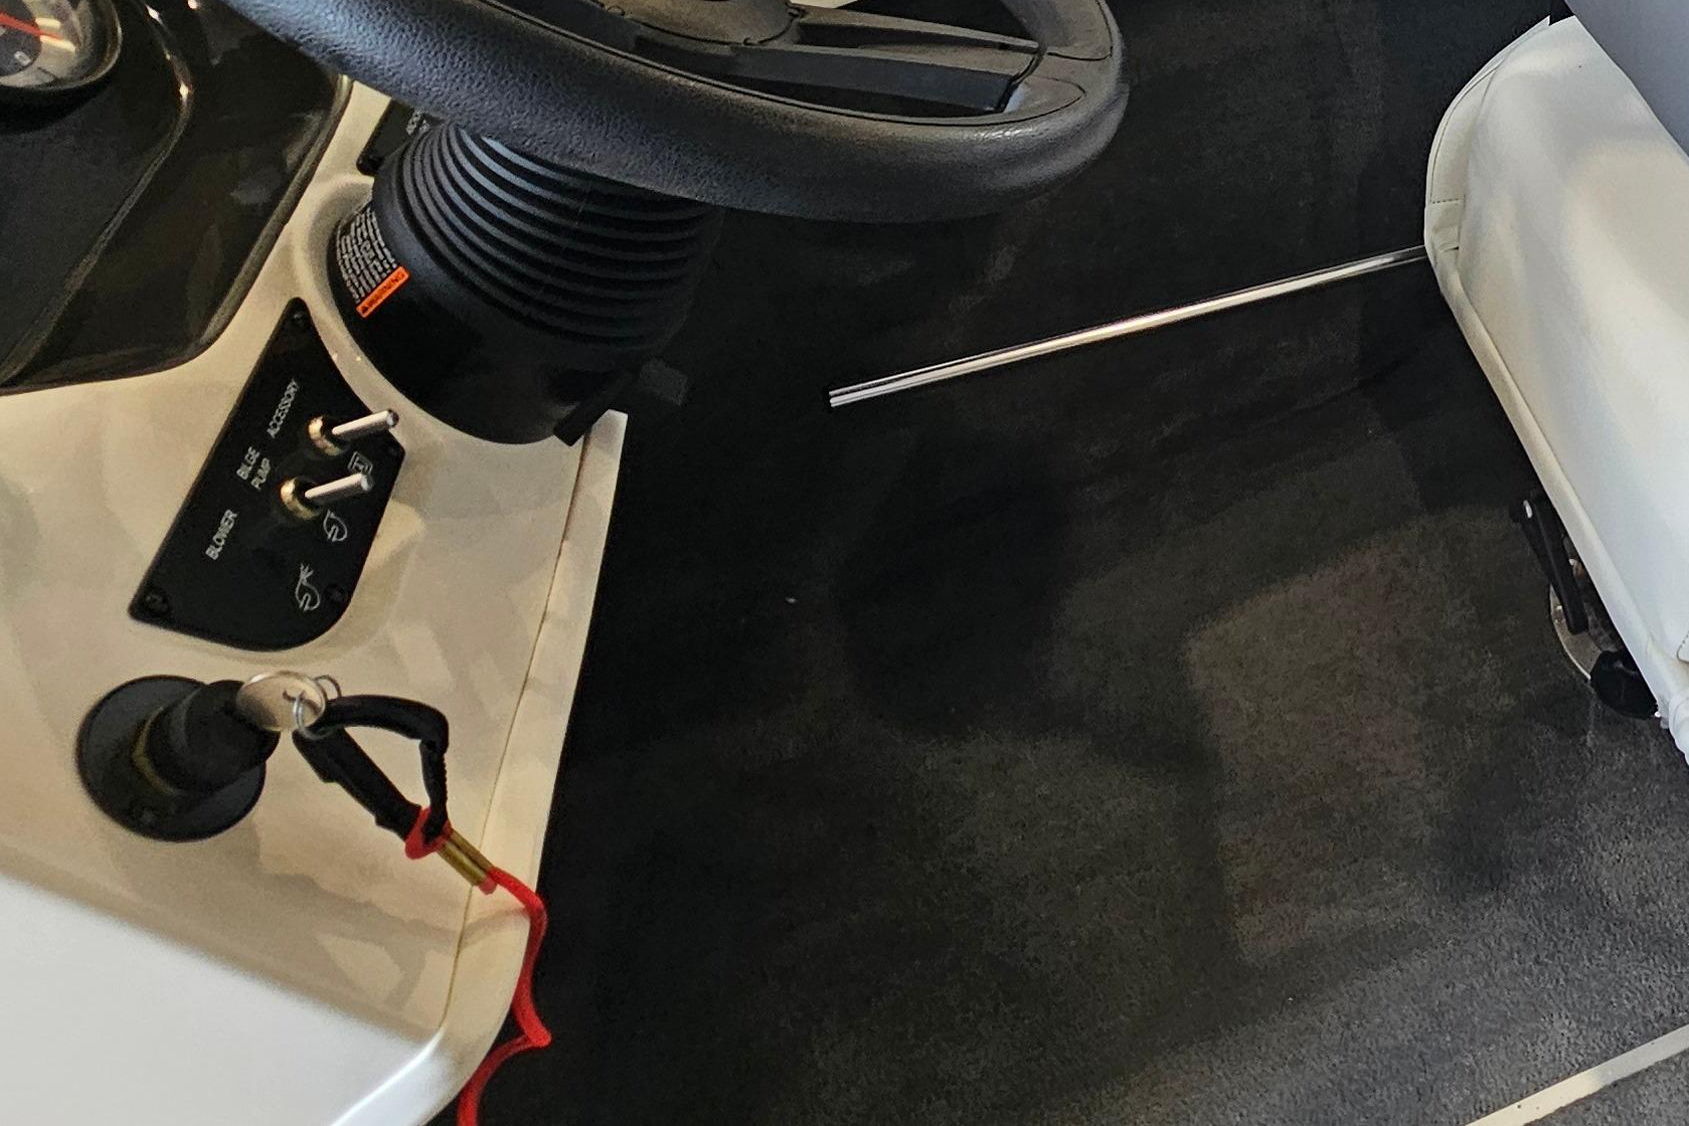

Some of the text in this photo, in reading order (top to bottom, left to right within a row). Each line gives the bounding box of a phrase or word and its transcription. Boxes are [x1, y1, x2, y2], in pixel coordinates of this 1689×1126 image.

[266, 378, 299, 439] ACCESSORY
[236, 446, 261, 481] BILGE
[250, 457, 272, 491] PUMP
[205, 508, 238, 561] BLOWER
